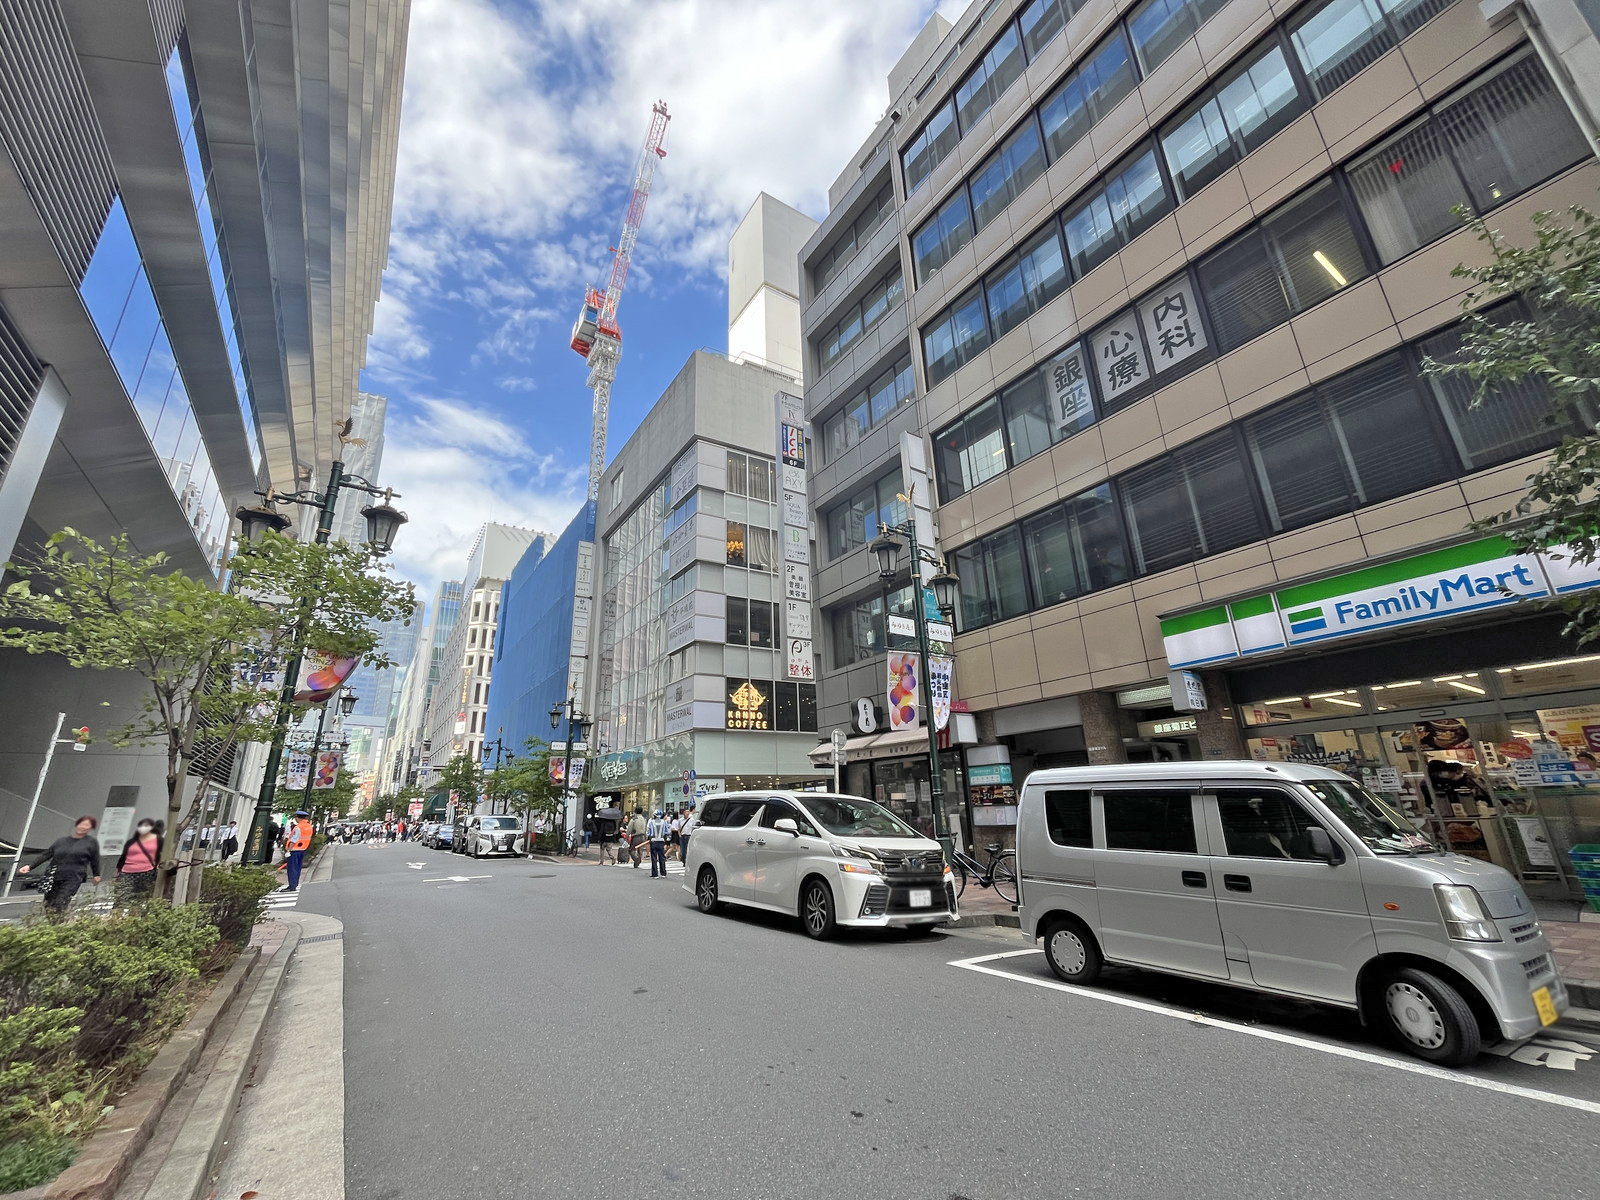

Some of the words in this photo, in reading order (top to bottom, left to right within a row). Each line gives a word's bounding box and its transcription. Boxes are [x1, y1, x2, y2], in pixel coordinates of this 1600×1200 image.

[1053, 355, 1089, 420] 銀座
[1104, 330, 1142, 391] 心療
[1153, 291, 1197, 359] 内科
[785, 476, 804, 489] AXY
[784, 493, 793, 501] 5F
[786, 565, 795, 573] 2F
[788, 589, 807, 598] 美容室
[1334, 563, 1535, 625] FamilyMart
[788, 603, 797, 611] 1F
[309, 658, 336, 666] GINZA
[789, 664, 812, 678] 整体
[667, 706, 692, 722] MASTERWAL
[728, 711, 763, 720] KANNO
[728, 720, 768, 729] COFFEE
[1540, 764, 1568, 772] たばこ
